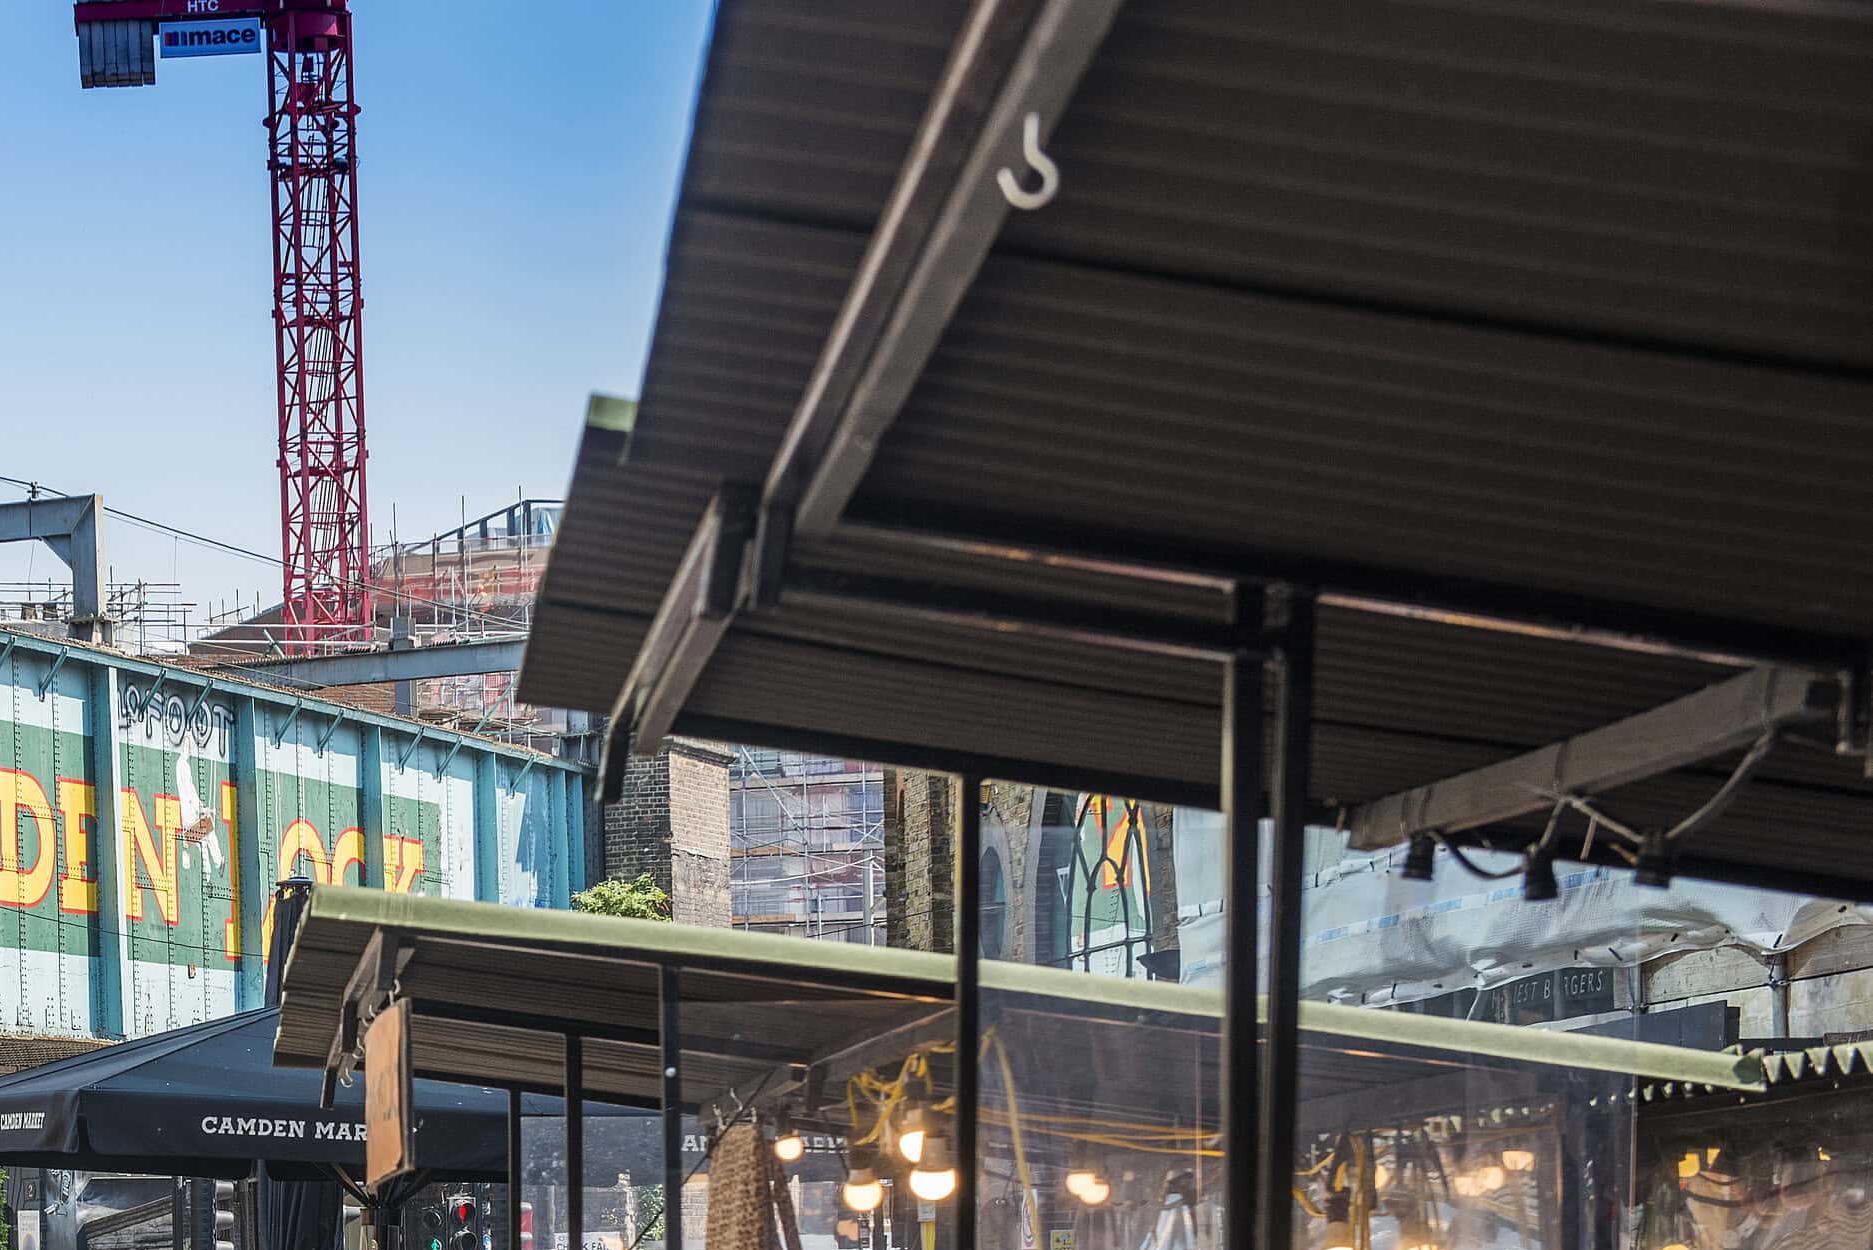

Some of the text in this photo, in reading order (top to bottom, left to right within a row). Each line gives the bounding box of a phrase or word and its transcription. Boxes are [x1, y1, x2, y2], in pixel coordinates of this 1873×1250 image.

[187, 0, 219, 12] HTC
[188, 28, 256, 46] mace
[1543, 970, 1604, 1000] BRGERS
[2, 1112, 46, 1130] CAMDEN MARKET
[201, 1116, 367, 1142] CAMDEN MAR
